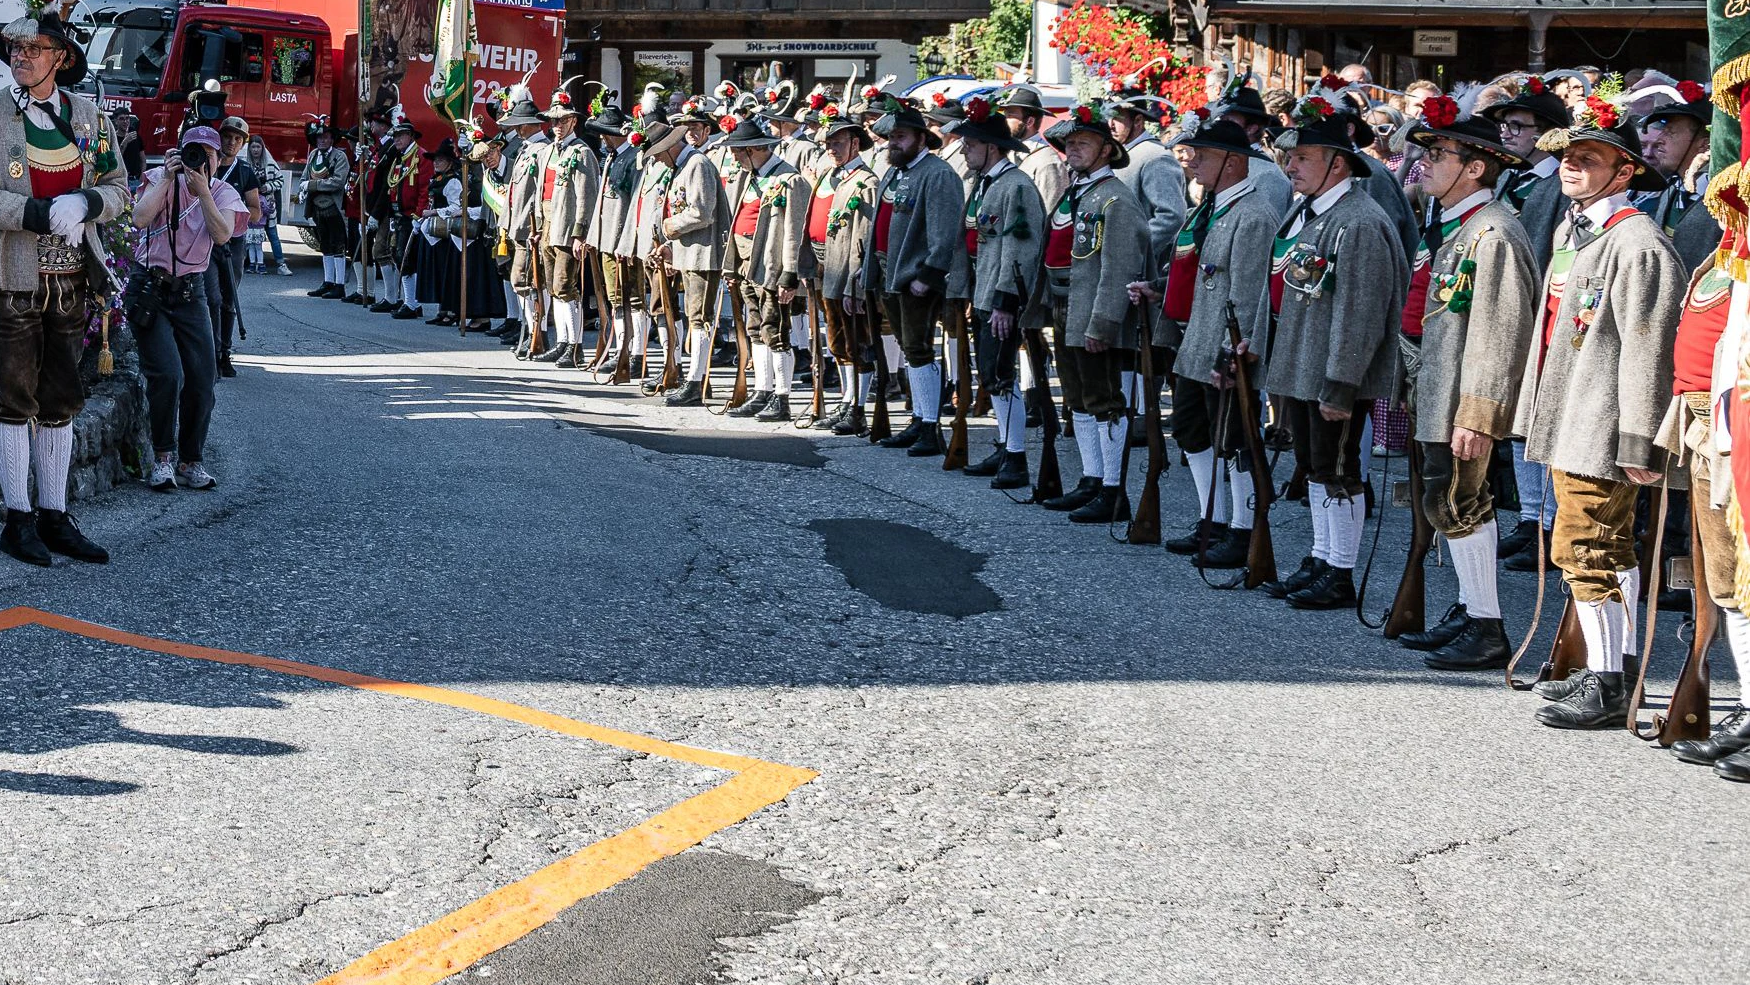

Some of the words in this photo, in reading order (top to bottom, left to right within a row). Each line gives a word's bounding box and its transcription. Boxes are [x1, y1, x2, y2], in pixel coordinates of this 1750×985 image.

[1418, 34, 1452, 42] Zimmer
[783, 41, 878, 52] SNOWBOARDSCHULE
[1428, 44, 1443, 52] frei
[562, 52, 577, 62] GANG
[666, 59, 690, 67] Service
[473, 79, 501, 104] 22
[270, 92, 297, 103] LASTA
